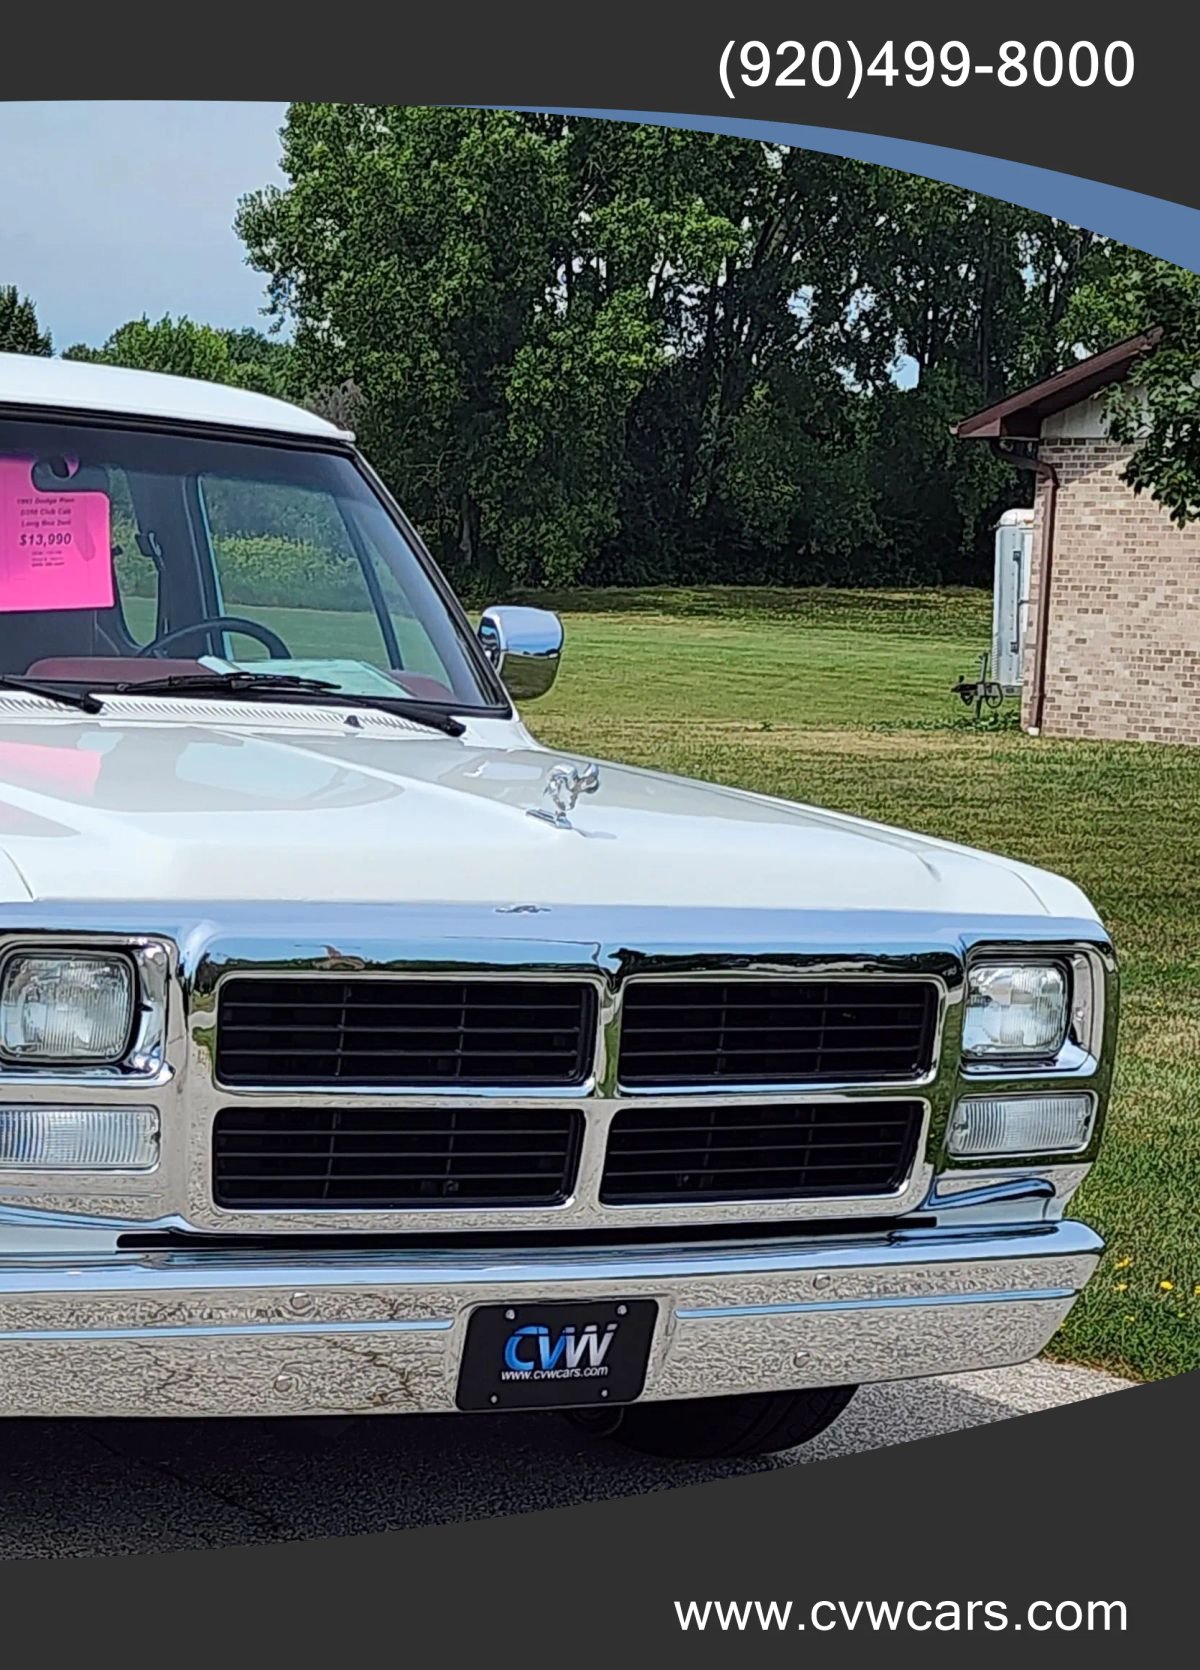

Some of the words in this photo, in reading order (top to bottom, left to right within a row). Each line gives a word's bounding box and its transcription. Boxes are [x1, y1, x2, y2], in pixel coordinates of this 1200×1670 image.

[19, 533, 72, 547] $13,990
[504, 1323, 618, 1370] CVW
[501, 1365, 608, 1380] www.cvwcars.com
